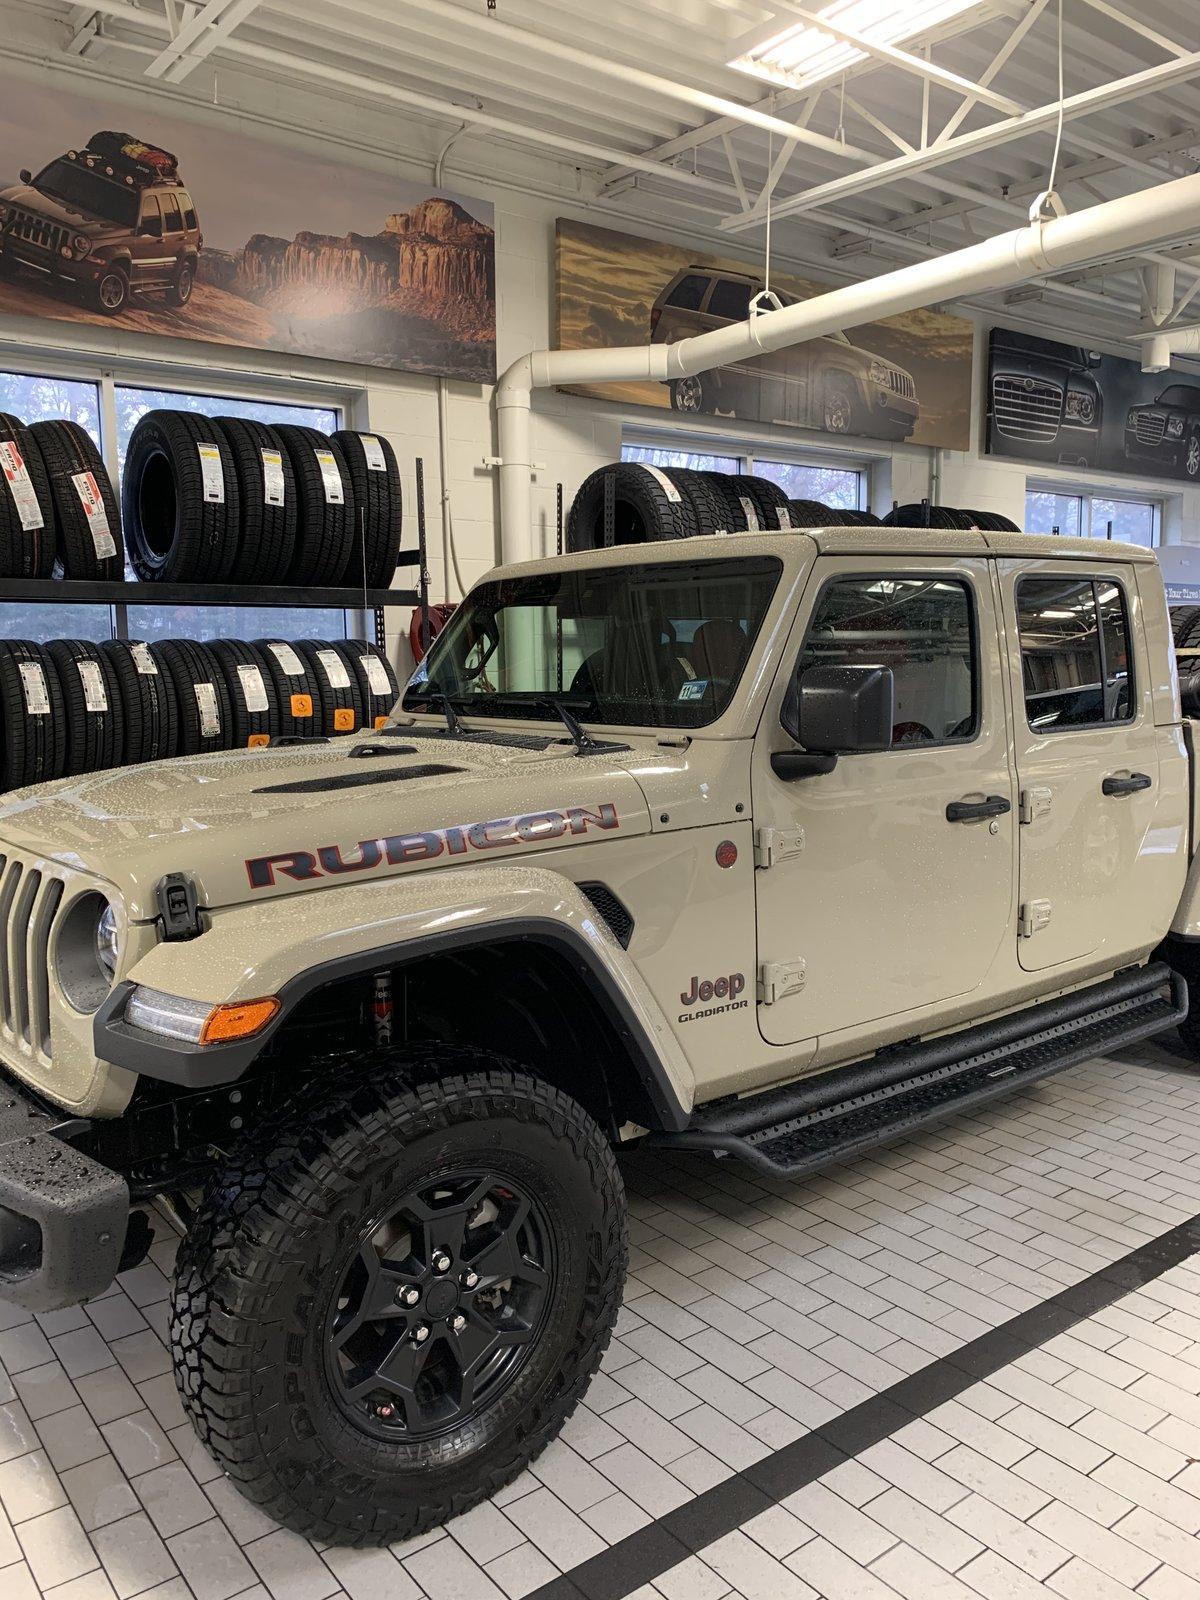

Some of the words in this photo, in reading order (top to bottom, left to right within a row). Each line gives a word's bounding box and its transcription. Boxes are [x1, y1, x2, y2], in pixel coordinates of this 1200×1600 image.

[4, 448, 18, 472] FR710
[82, 481, 96, 505] FR710
[244, 803, 620, 889] RUBICON
[680, 973, 745, 1005] Jeep
[678, 1000, 748, 1023] GLADIATOR
